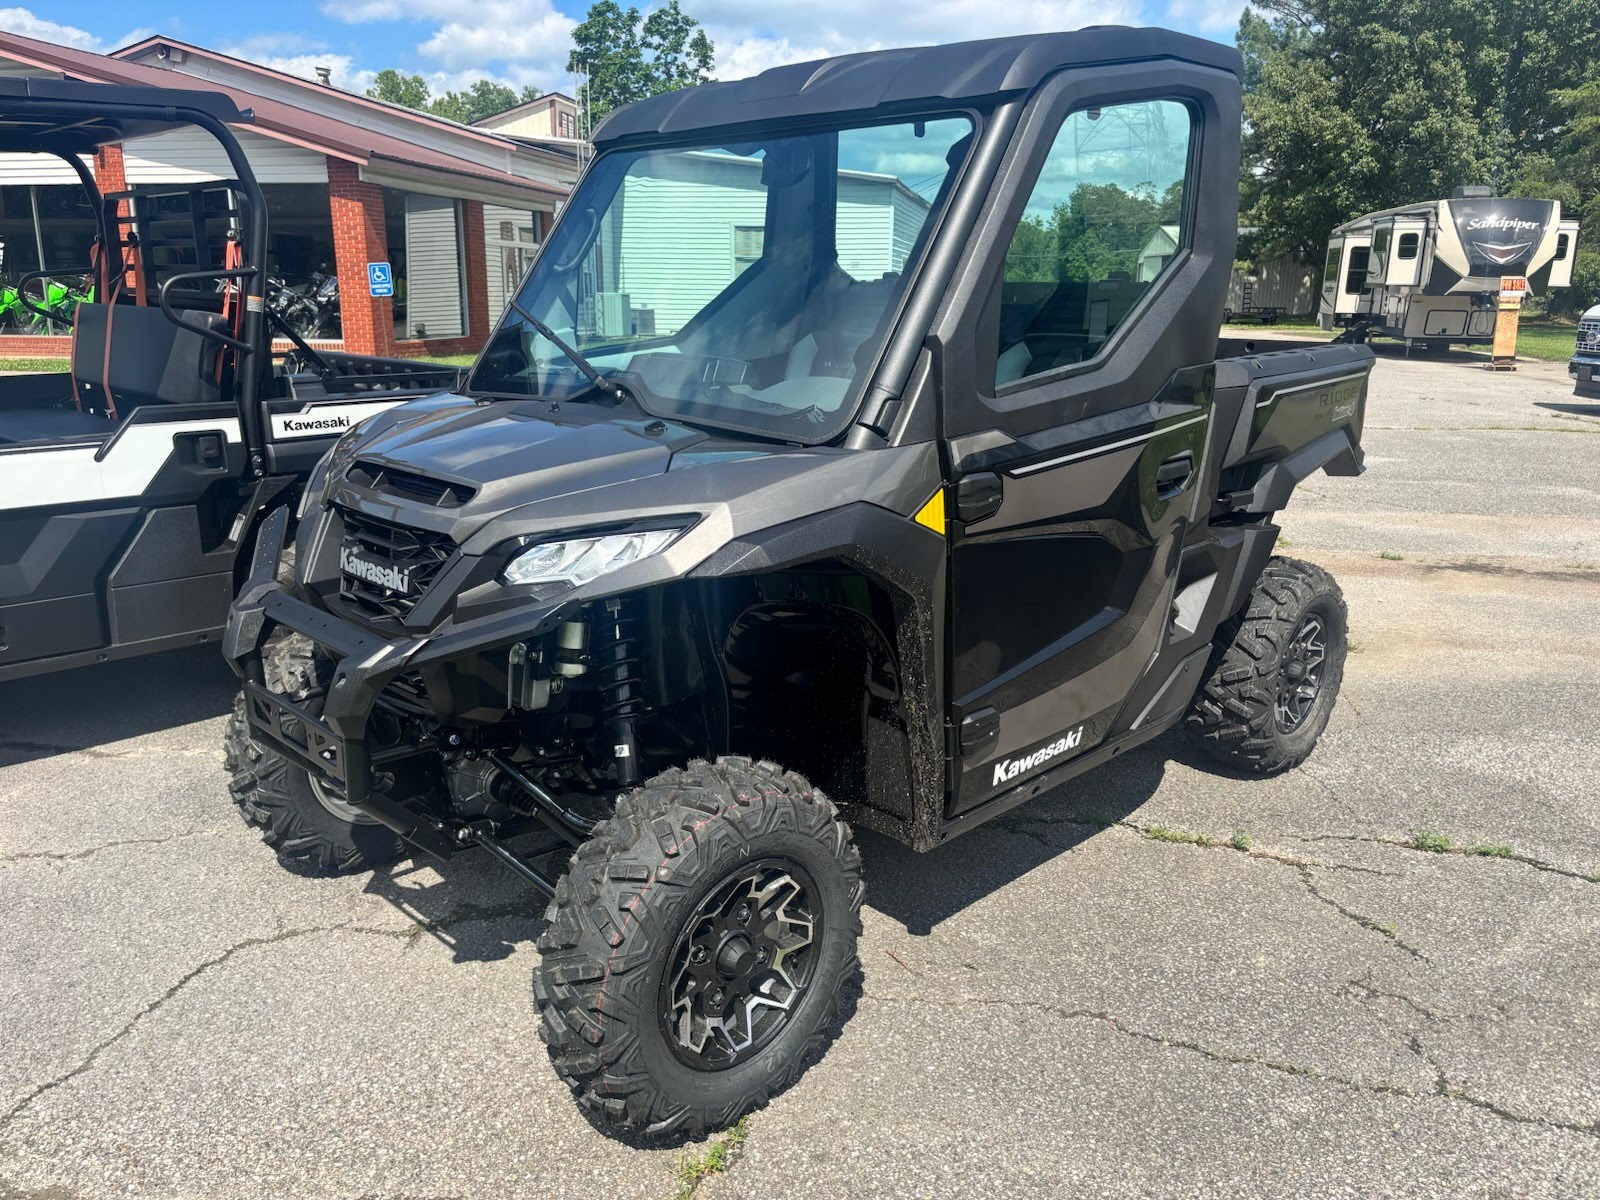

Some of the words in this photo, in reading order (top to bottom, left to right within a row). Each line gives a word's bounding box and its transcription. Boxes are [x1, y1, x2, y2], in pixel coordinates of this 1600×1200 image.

[1467, 215, 1540, 231] Sandpiper
[283, 416, 350, 431] Kawasaki
[340, 546, 409, 593] Kawasaki
[992, 725, 1084, 787] Kawasaki
